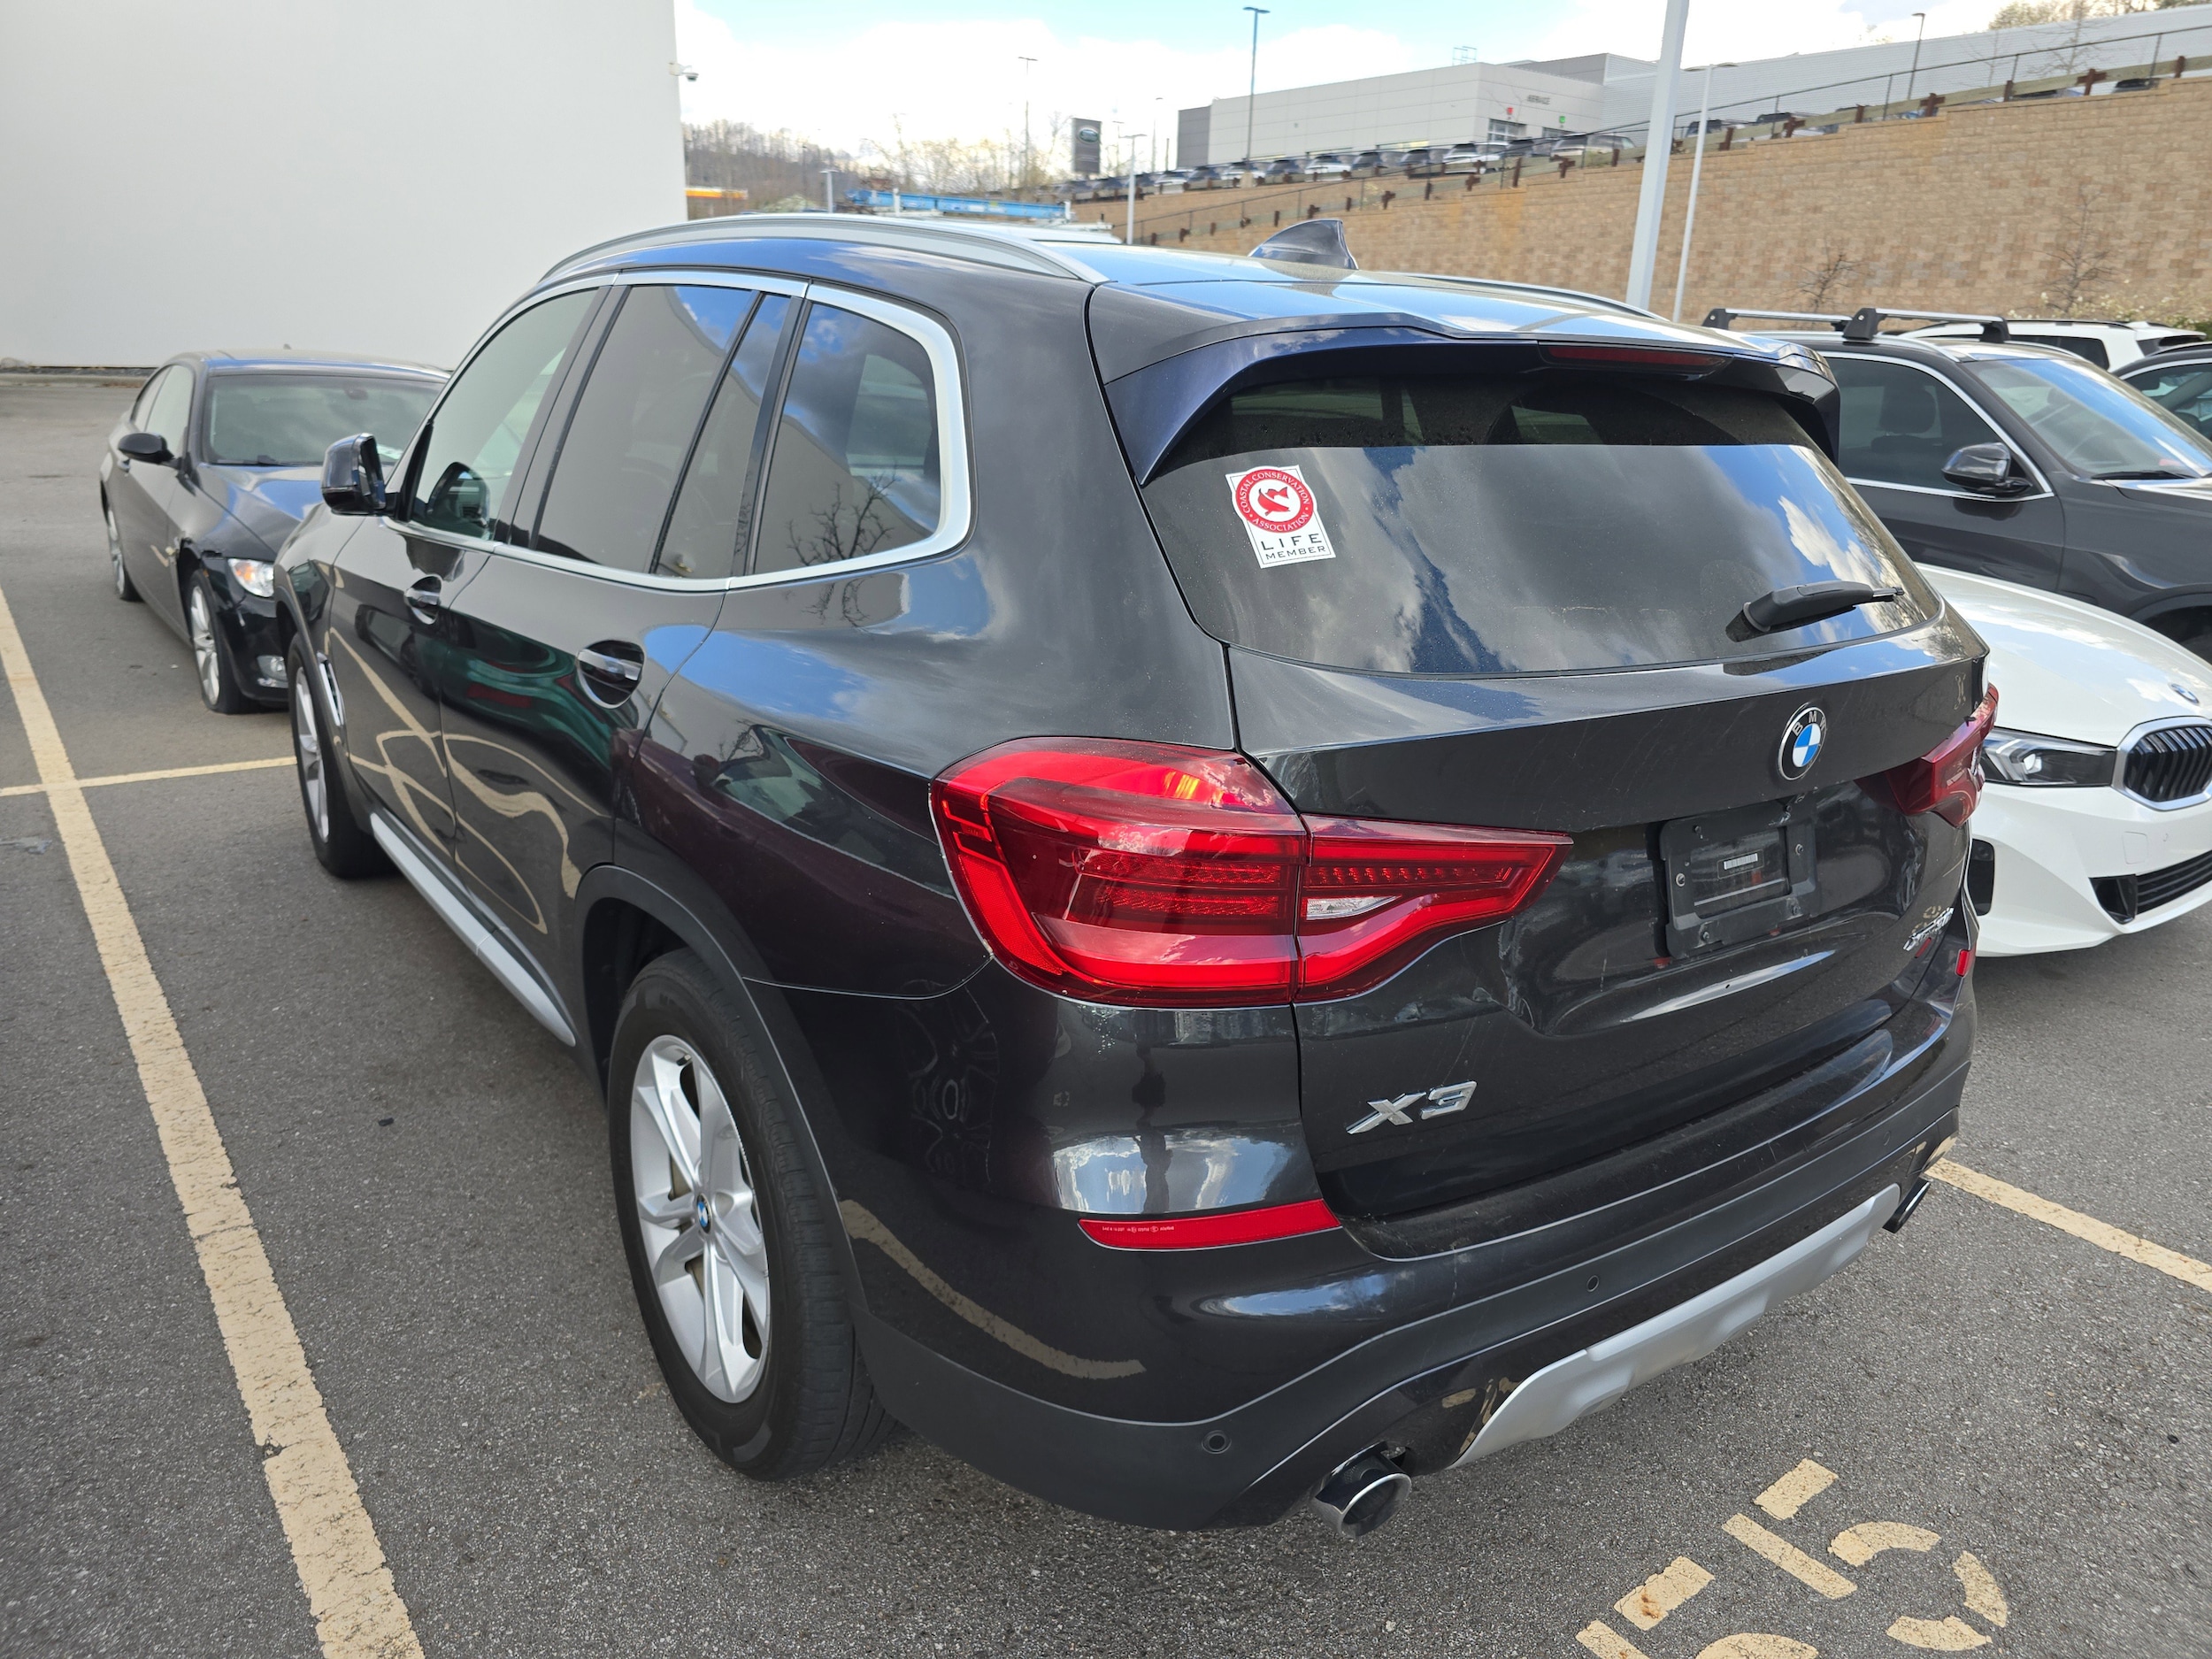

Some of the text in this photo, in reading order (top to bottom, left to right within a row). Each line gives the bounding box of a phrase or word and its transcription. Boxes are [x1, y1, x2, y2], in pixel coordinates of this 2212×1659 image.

[1239, 471, 1311, 514] COASTAL CONSERVATION
[1253, 512, 1310, 532] ASSOCIATION
[1261, 533, 1323, 551] LIFE
[1265, 545, 1326, 560] MEMBER
[1792, 710, 1827, 736] BMW
[1345, 1079, 1478, 1134] X3
